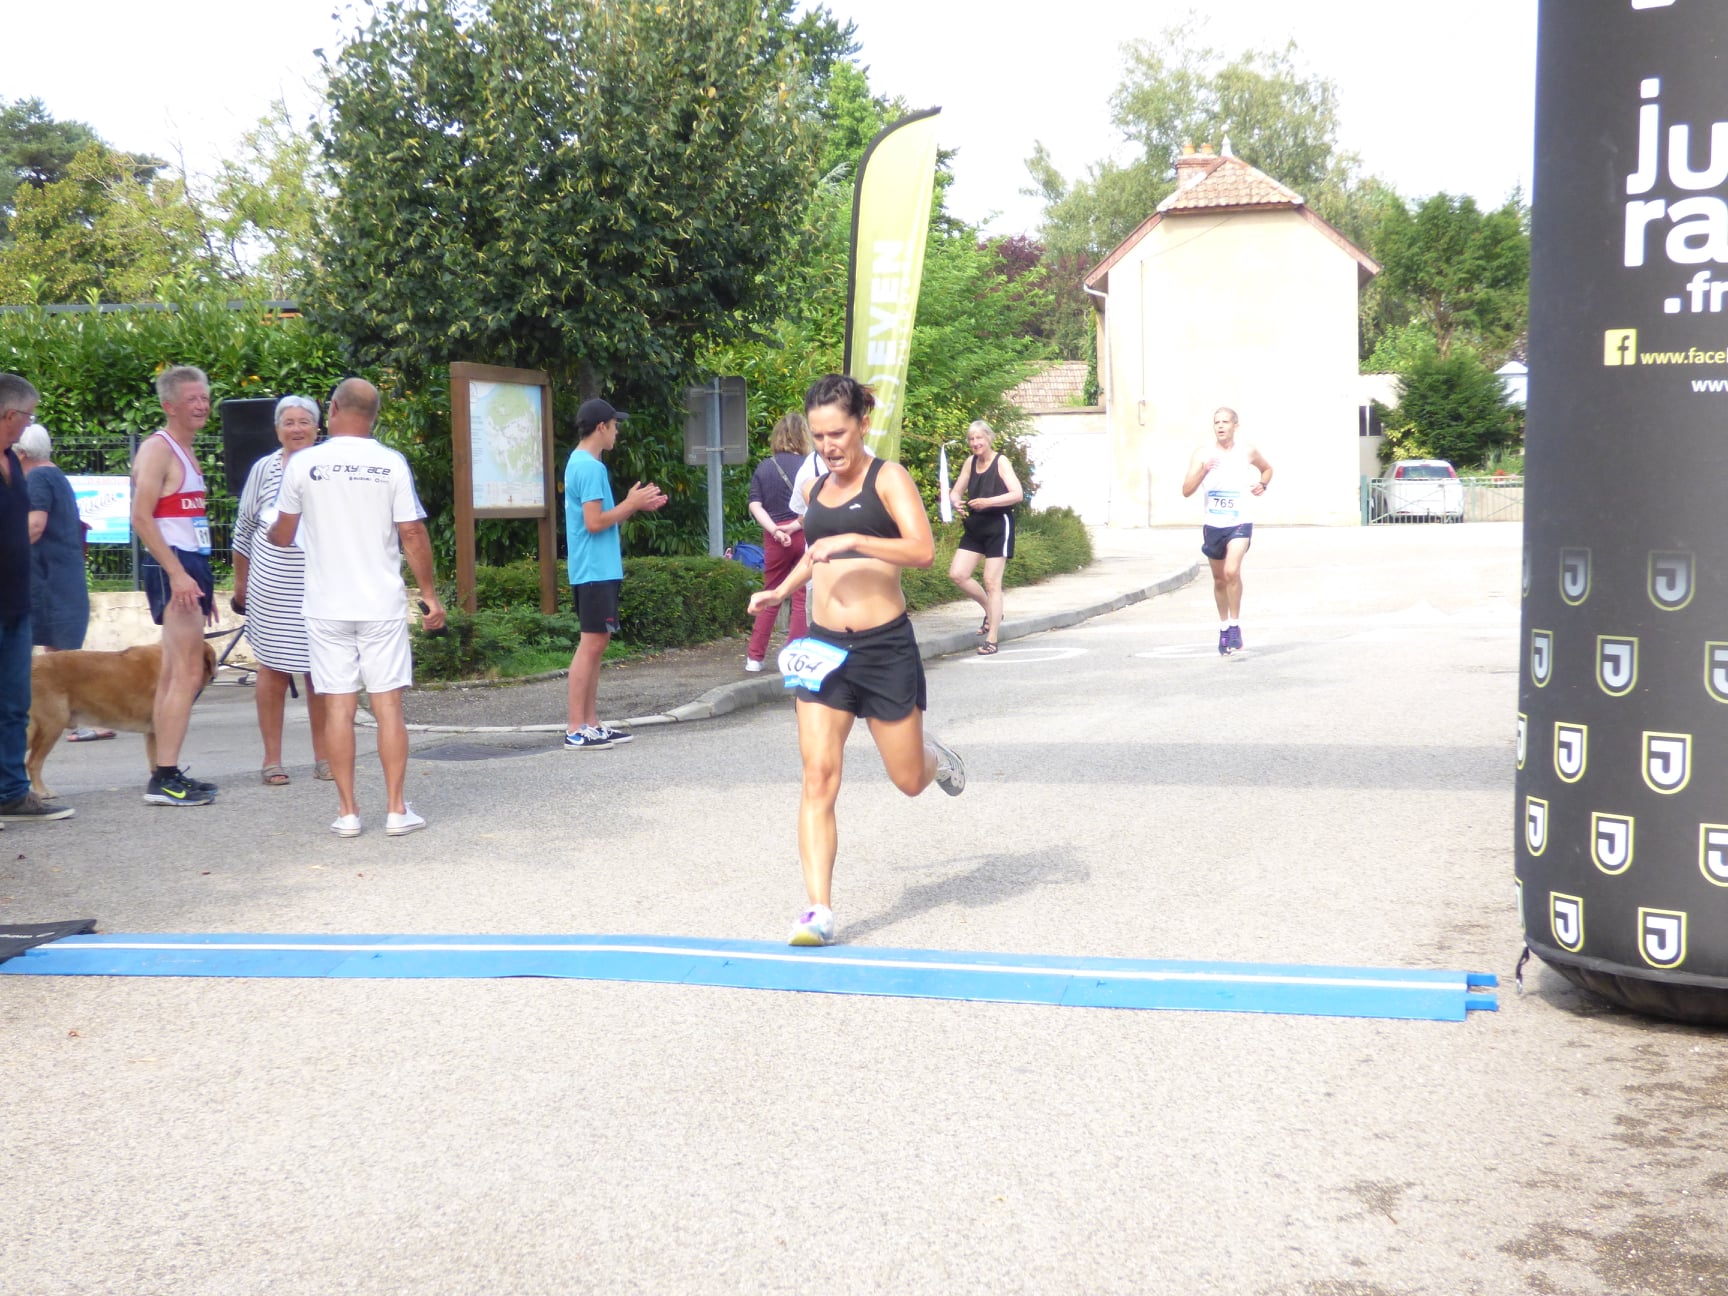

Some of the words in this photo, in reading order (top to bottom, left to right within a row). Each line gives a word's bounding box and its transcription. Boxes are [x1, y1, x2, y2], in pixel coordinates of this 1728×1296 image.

[867, 240, 904, 366] EVEN
[1640, 346, 1728, 365] www.face
[1213, 498, 1234, 508] 765
[787, 653, 824, 672] 764
